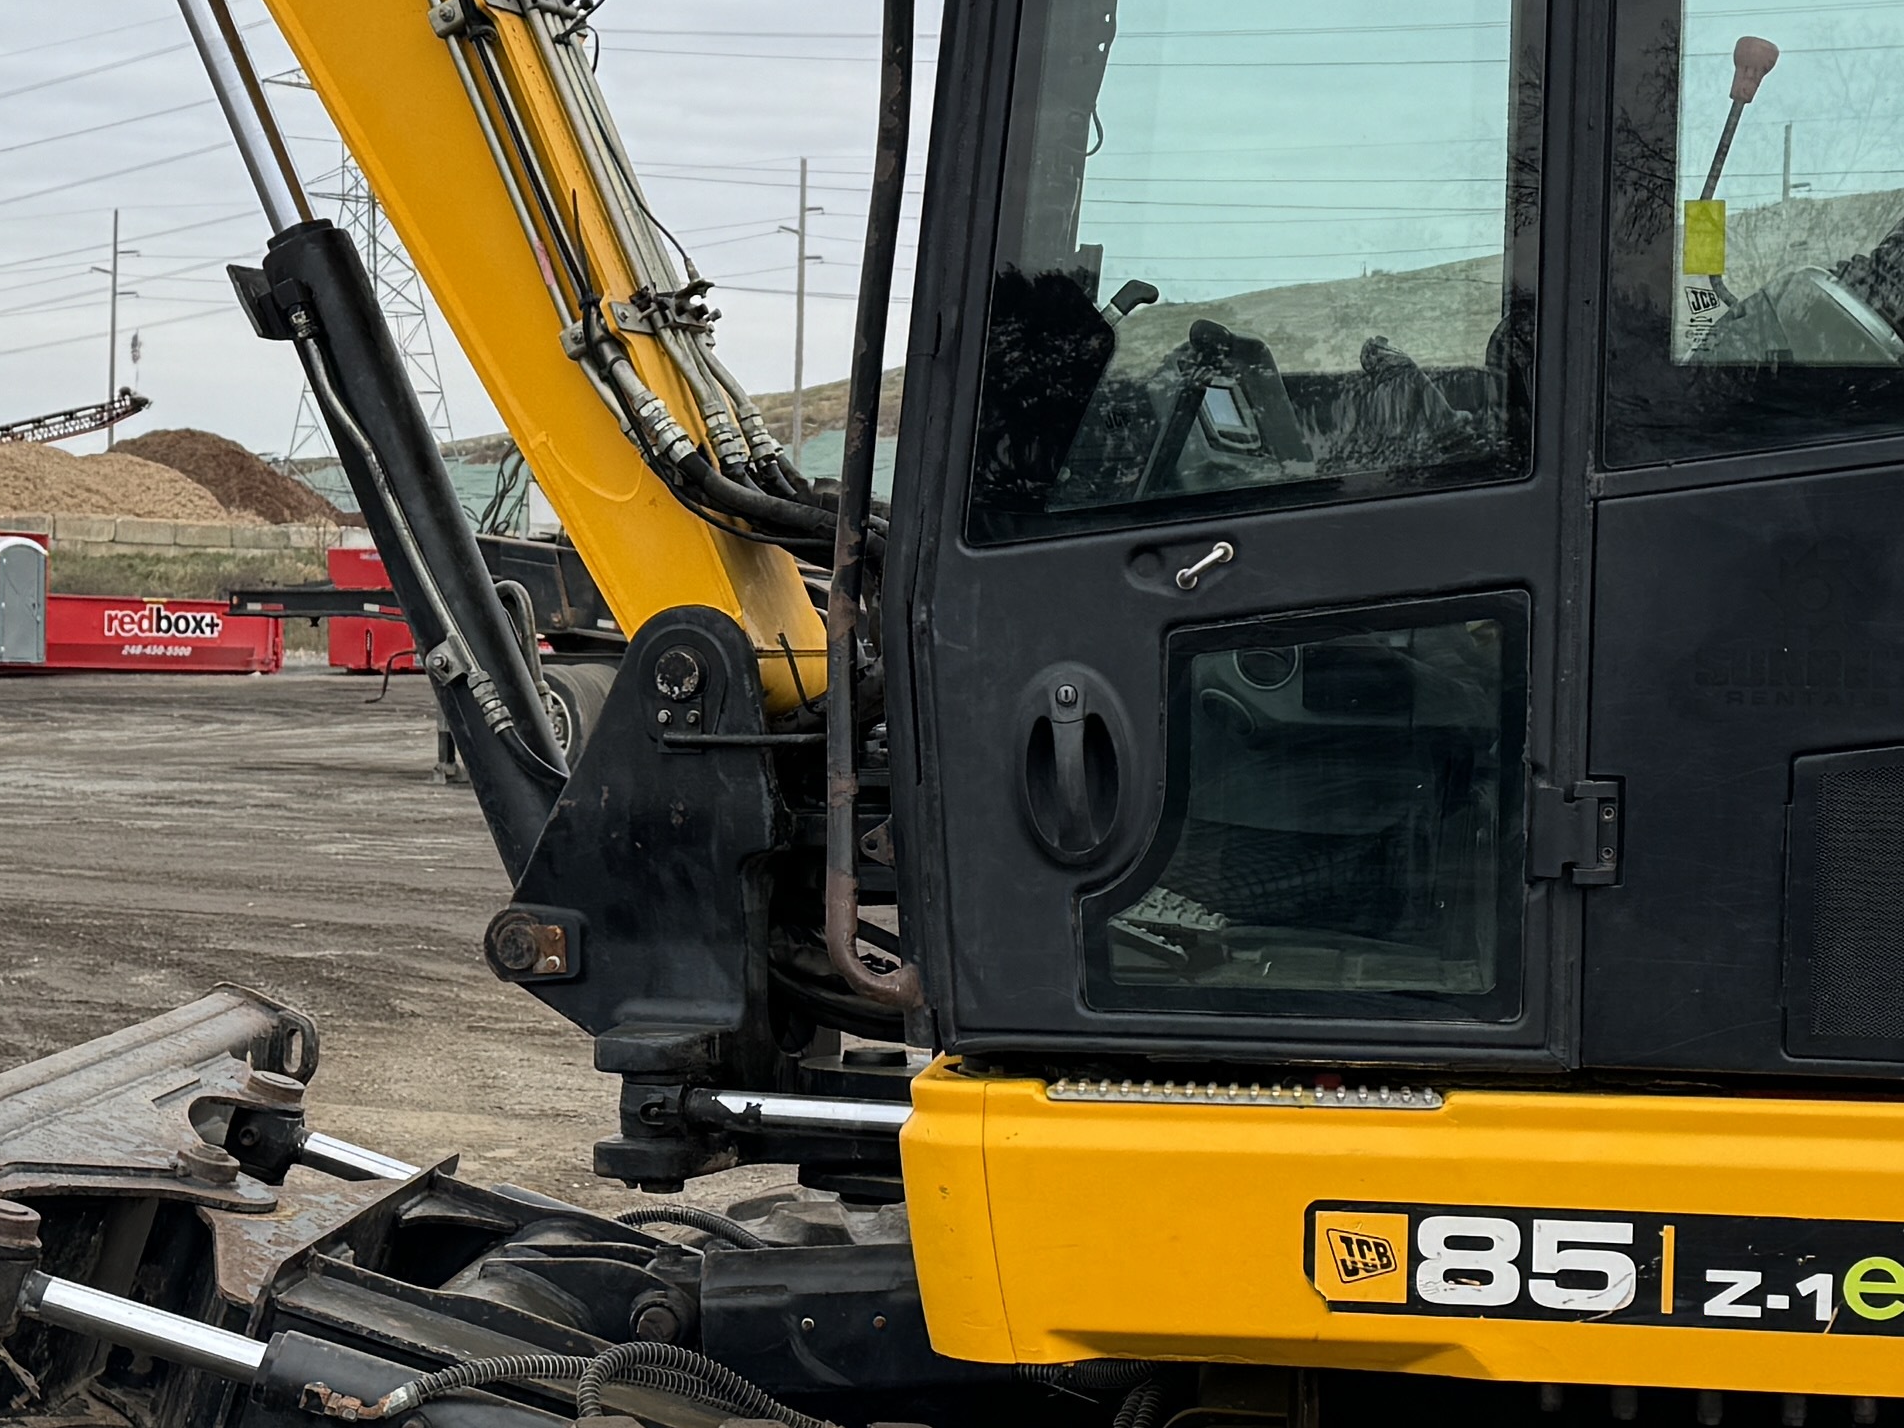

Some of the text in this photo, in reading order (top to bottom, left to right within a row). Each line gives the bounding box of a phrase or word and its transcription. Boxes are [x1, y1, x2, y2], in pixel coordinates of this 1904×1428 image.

[1687, 289, 1717, 311] JCB
[104, 604, 222, 638] redbox+
[1338, 1234, 1393, 1278] JCB
[1417, 1215, 1637, 1311] 85
